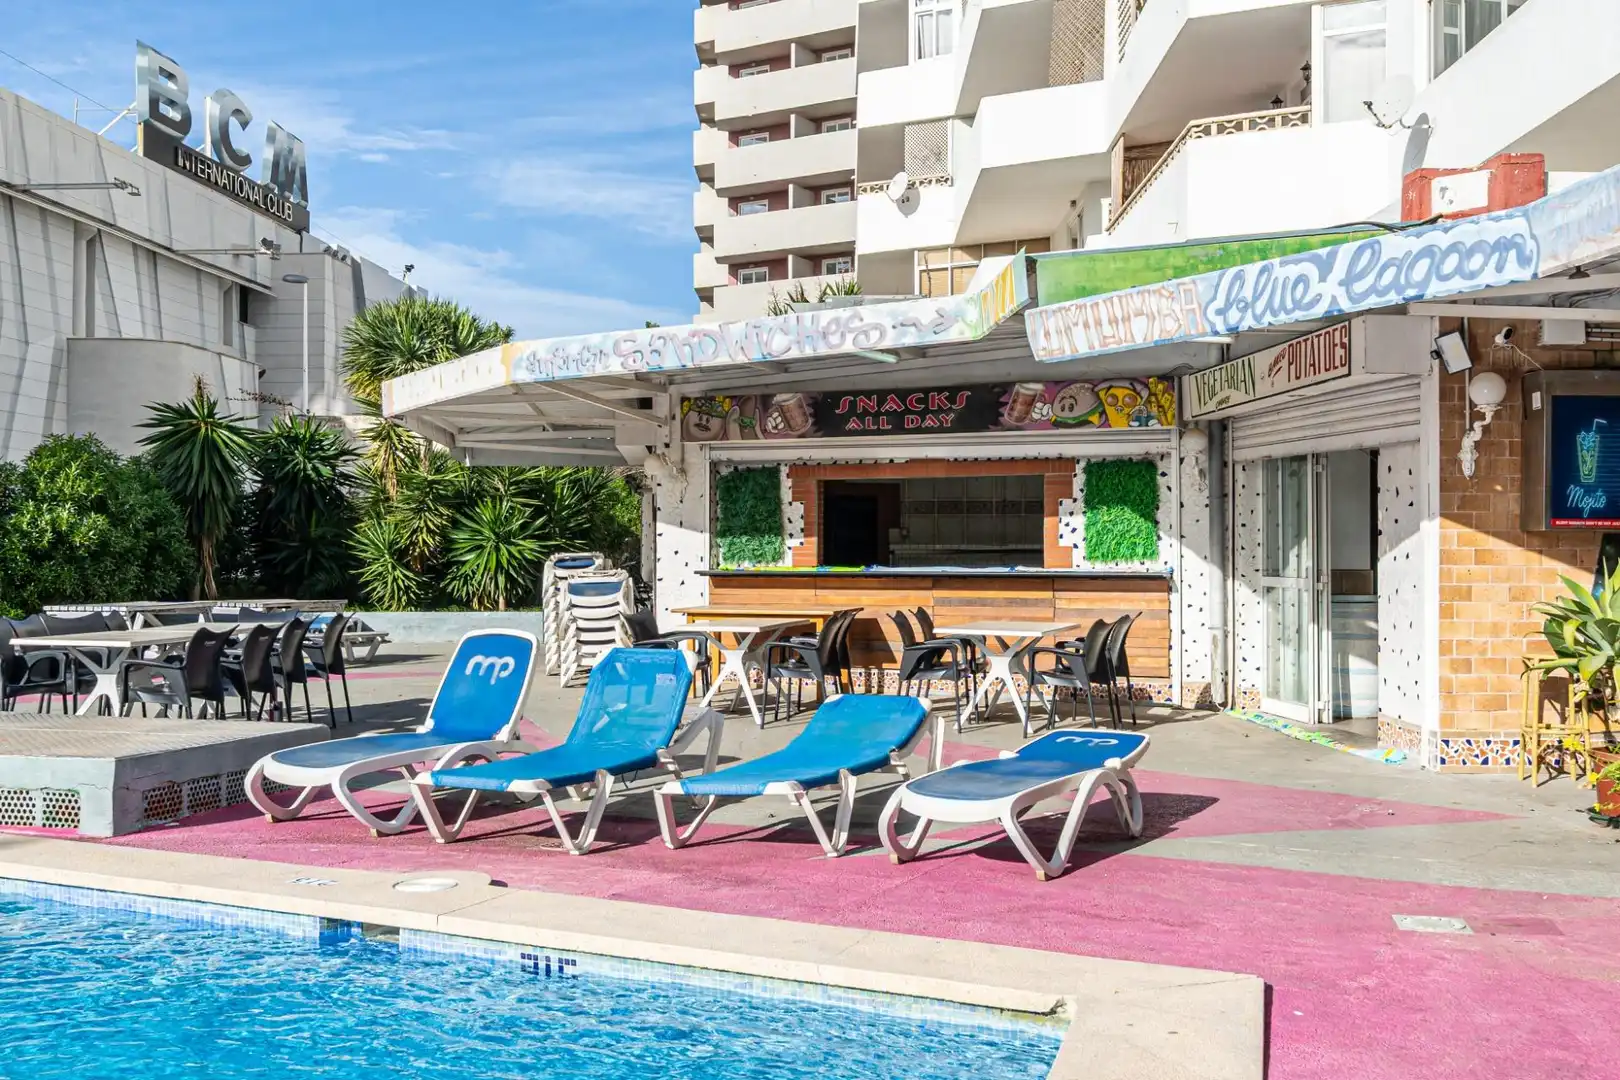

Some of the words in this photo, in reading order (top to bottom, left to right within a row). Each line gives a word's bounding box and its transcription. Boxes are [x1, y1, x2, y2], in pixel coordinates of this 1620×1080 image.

[136, 39, 308, 210] BCM
[175, 146, 266, 209] INTERNATIONAL
[267, 193, 293, 222] CLUB
[1287, 325, 1348, 383] POTATOES
[835, 391, 972, 414] SNACKS
[1194, 355, 1256, 411] VEGETARIAN
[845, 416, 892, 431] ALL
[904, 413, 955, 429] DAY
[1566, 484, 1607, 518] Mojito
